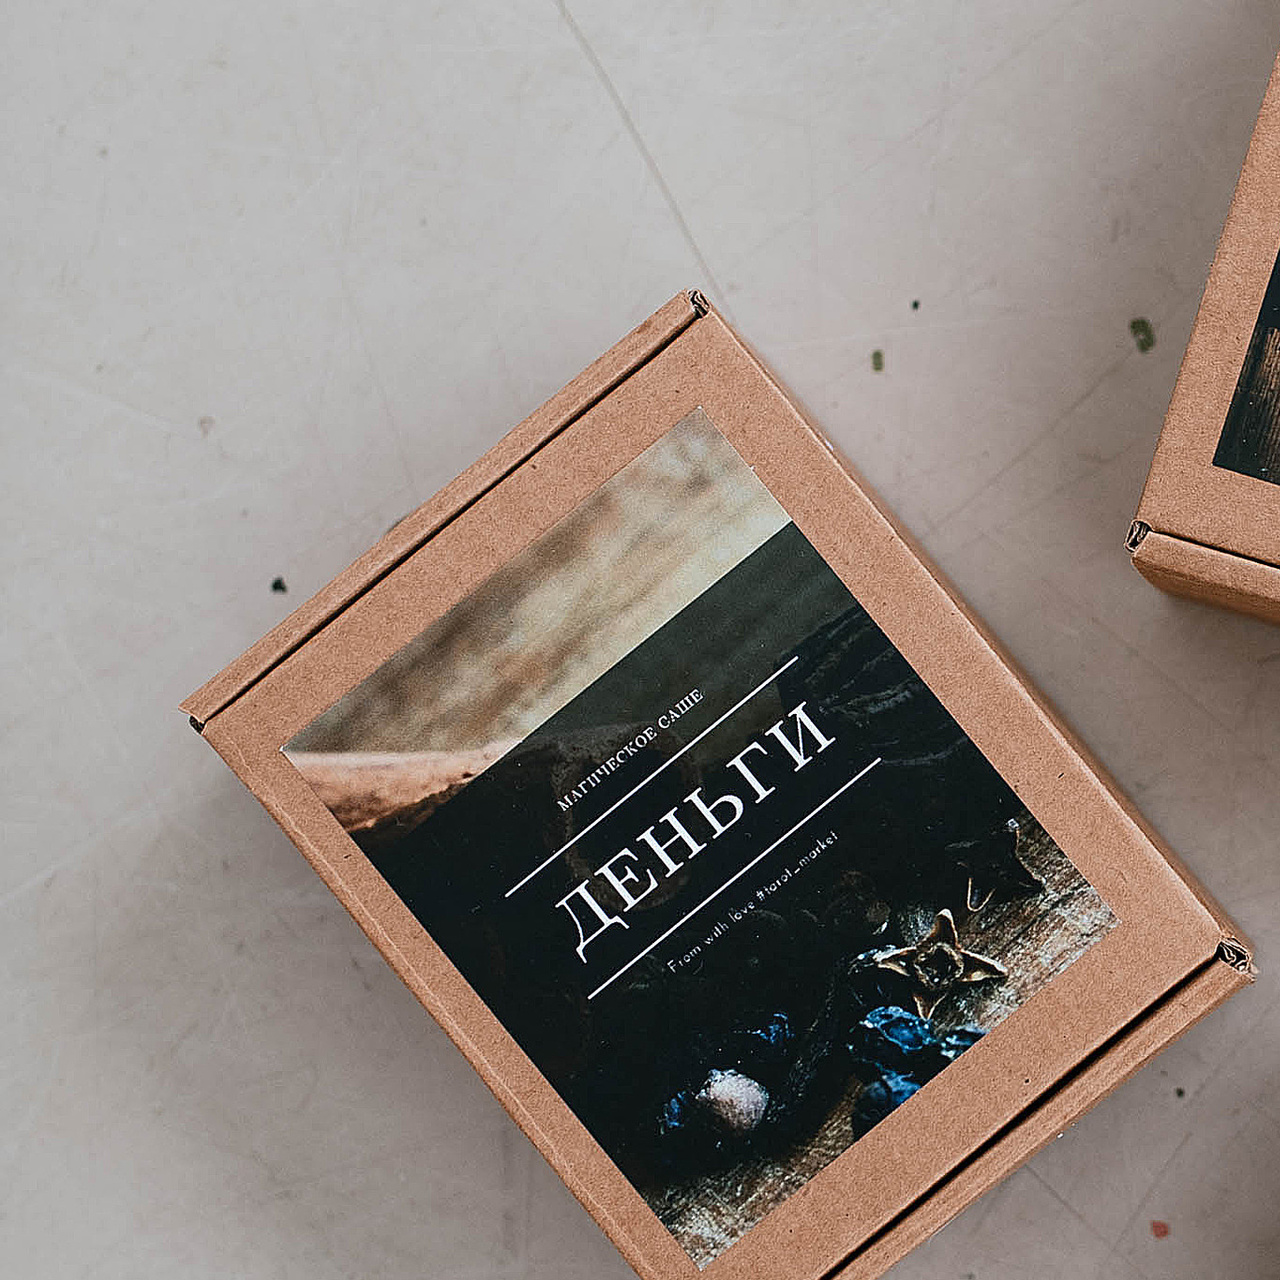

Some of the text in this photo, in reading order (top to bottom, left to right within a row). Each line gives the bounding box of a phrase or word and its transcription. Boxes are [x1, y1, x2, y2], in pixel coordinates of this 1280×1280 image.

[556, 688, 705, 812] МАГИЧЕСКОЕ САШЕ
[554, 701, 836, 964] ДЕНЬГИ
[667, 944, 702, 974] From
[703, 921, 730, 948] with
[731, 899, 757, 923] love
